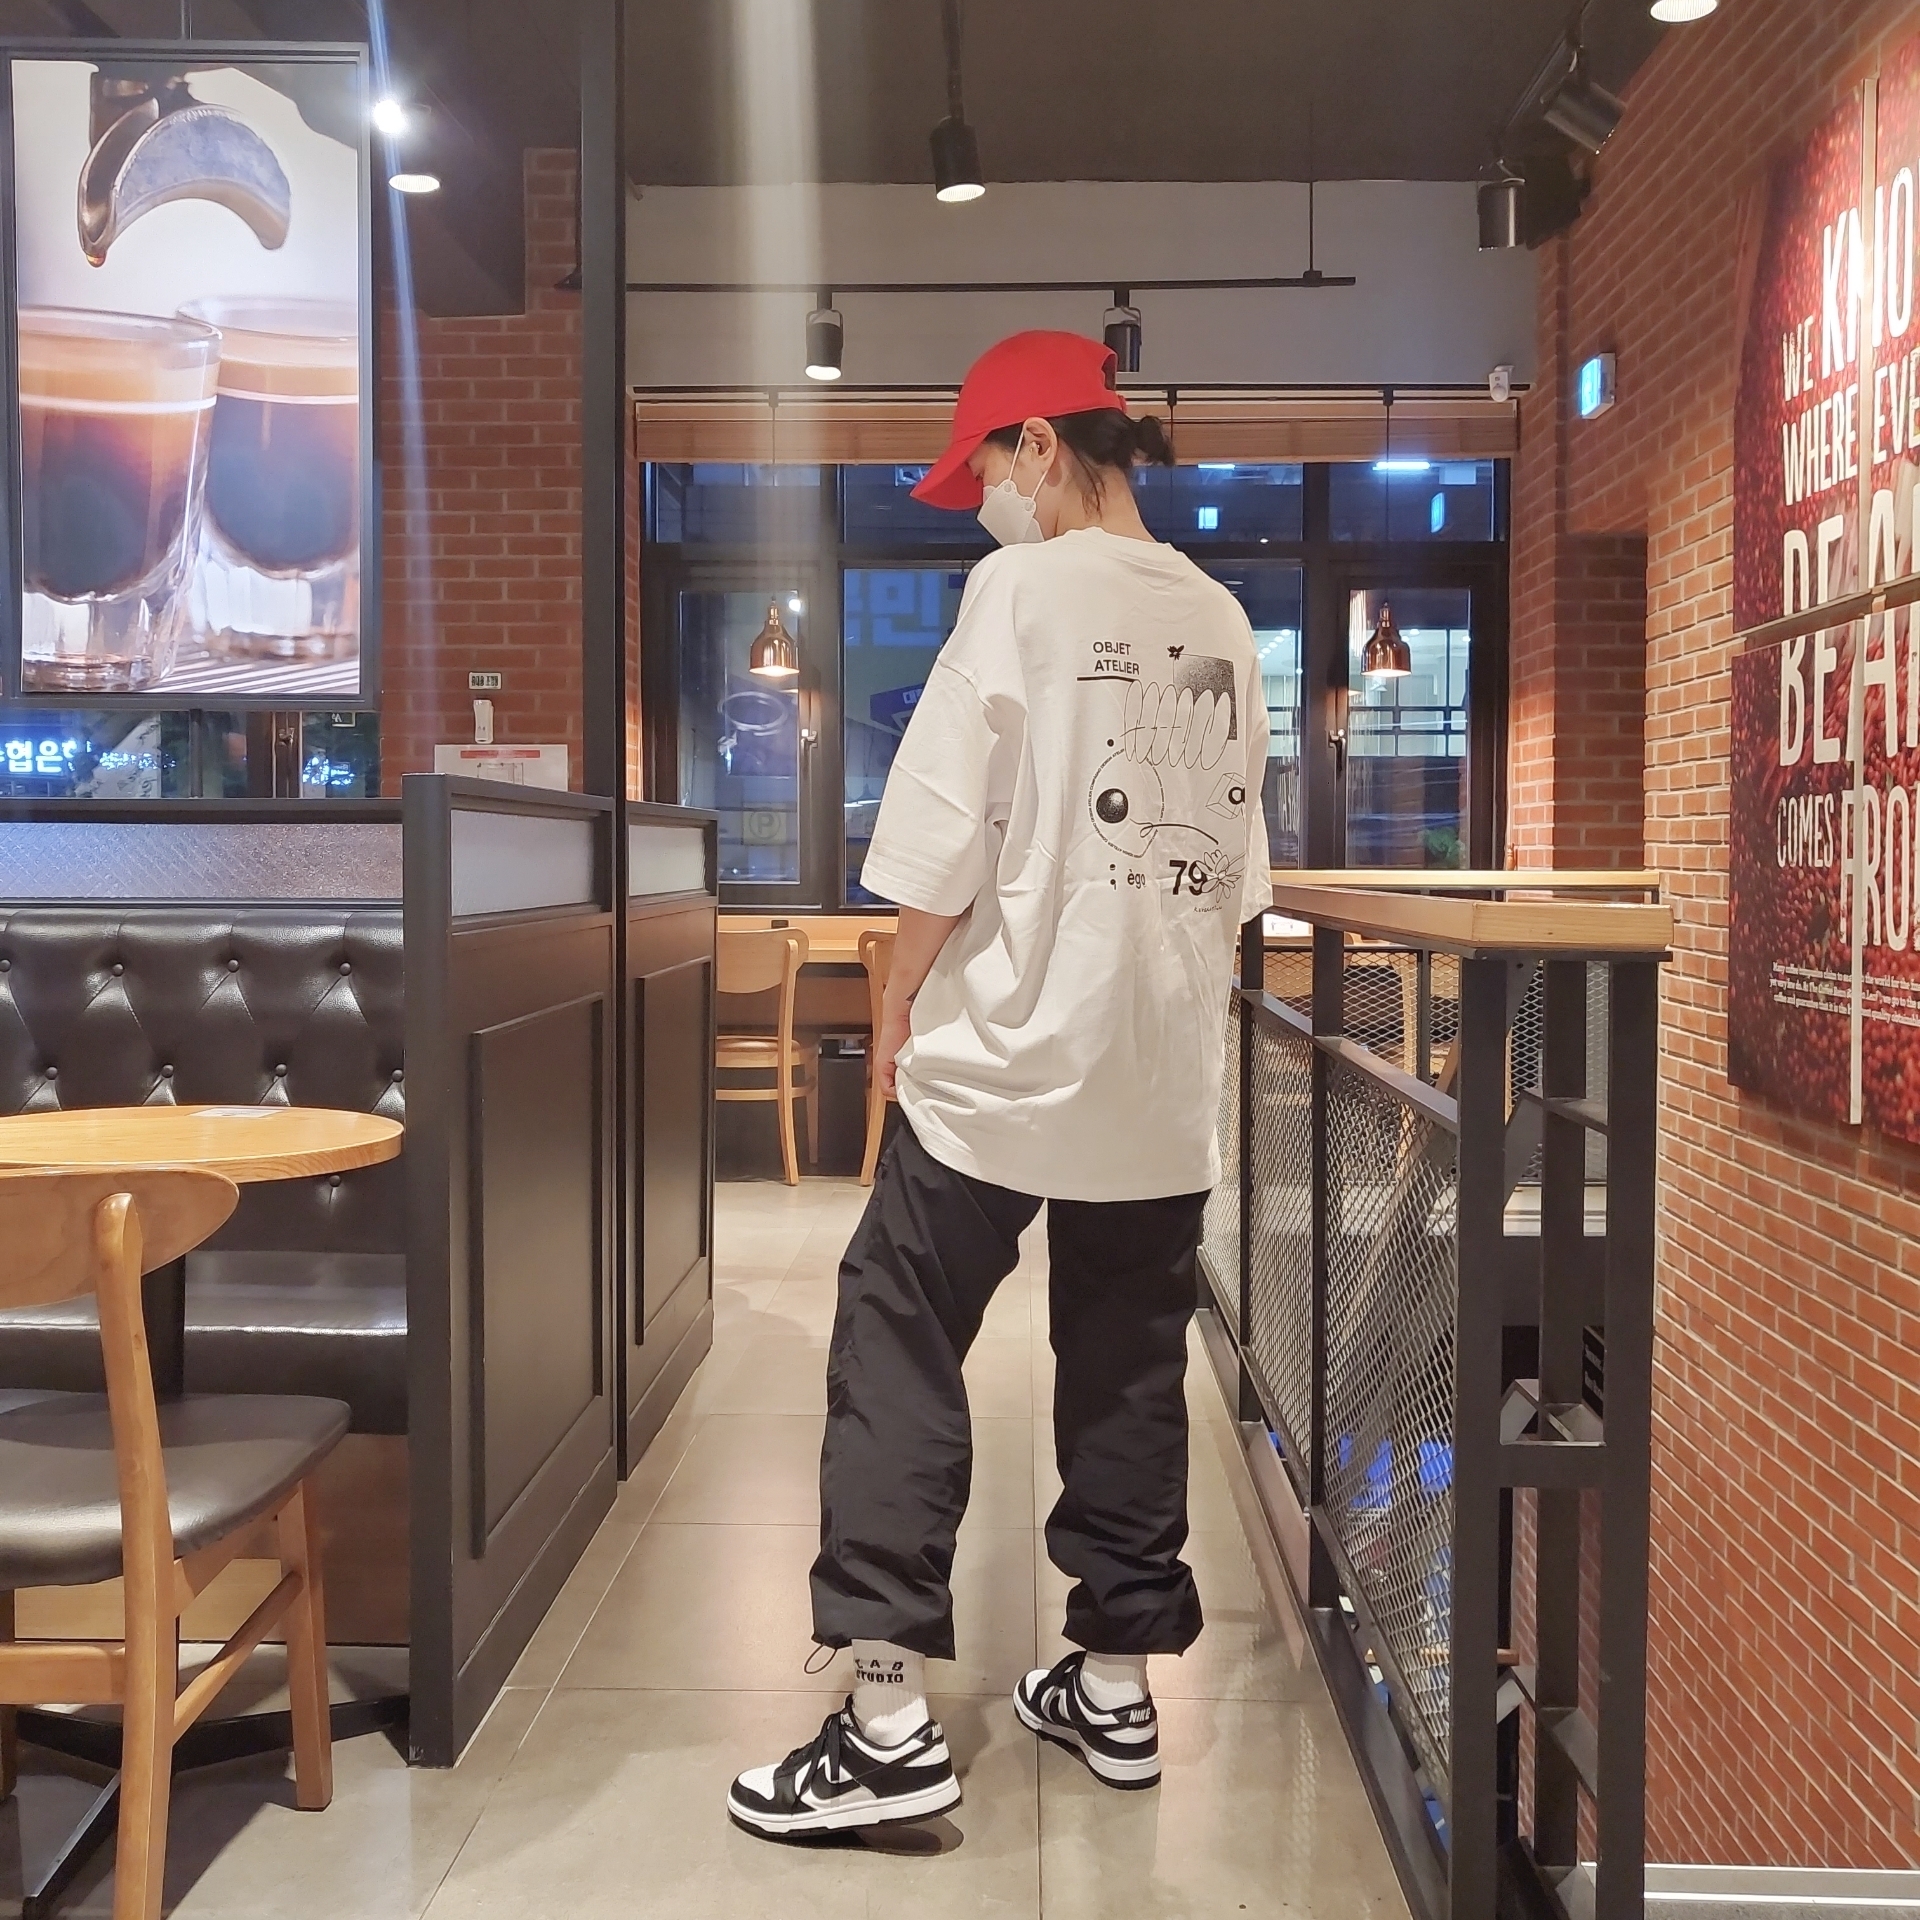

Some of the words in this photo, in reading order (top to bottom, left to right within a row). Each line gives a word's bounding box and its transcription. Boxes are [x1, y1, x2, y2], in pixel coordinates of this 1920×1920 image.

[1782, 318, 1814, 401] WE
[1821, 156, 1920, 379] KNO
[1782, 383, 1858, 506] WHERE
[1093, 641, 1131, 655] OBJET
[1094, 660, 1139, 675] ATELIER
[1777, 792, 1836, 868] COMES
[1169, 860, 1208, 896] 79
[1128, 1706, 1151, 1723] NIKE
